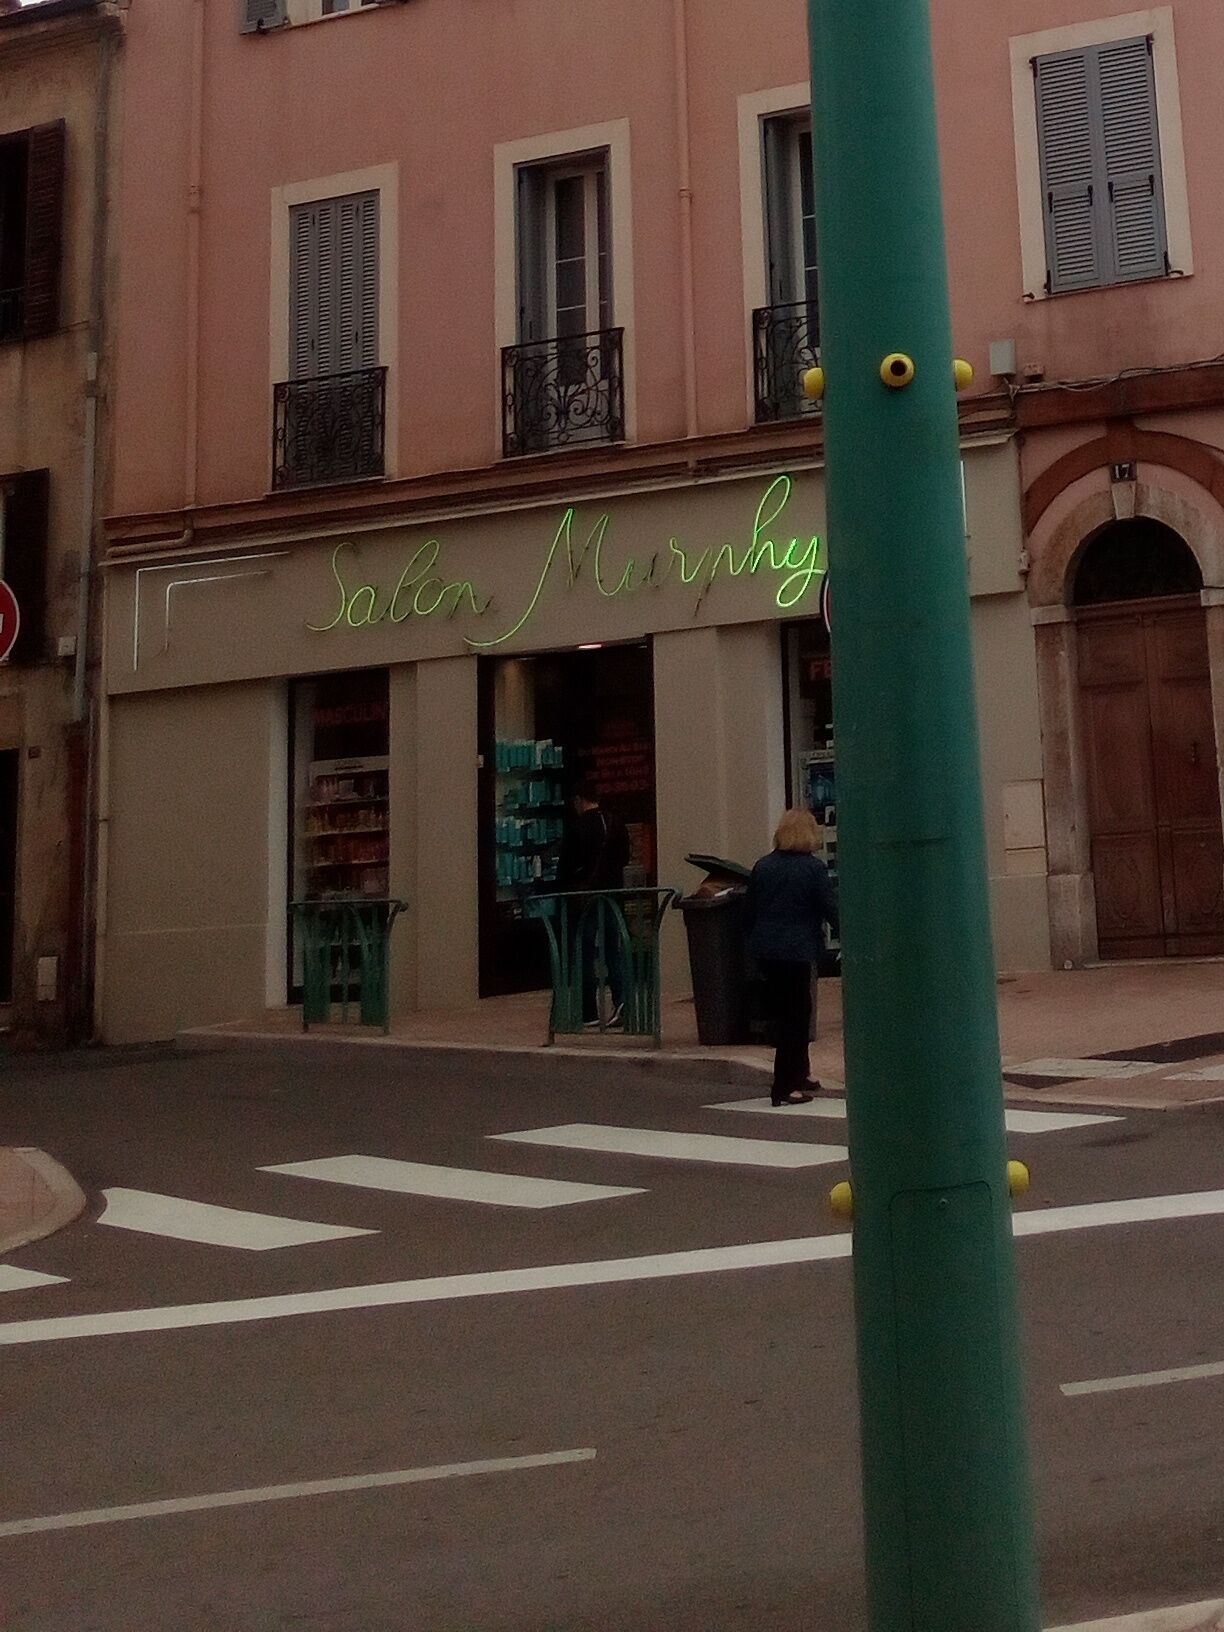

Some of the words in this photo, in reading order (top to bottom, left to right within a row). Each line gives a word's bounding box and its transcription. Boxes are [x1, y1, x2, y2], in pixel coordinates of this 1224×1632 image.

[1114, 463, 1130, 480] 17
[305, 541, 495, 632] Salon
[463, 474, 826, 647] Murphy
